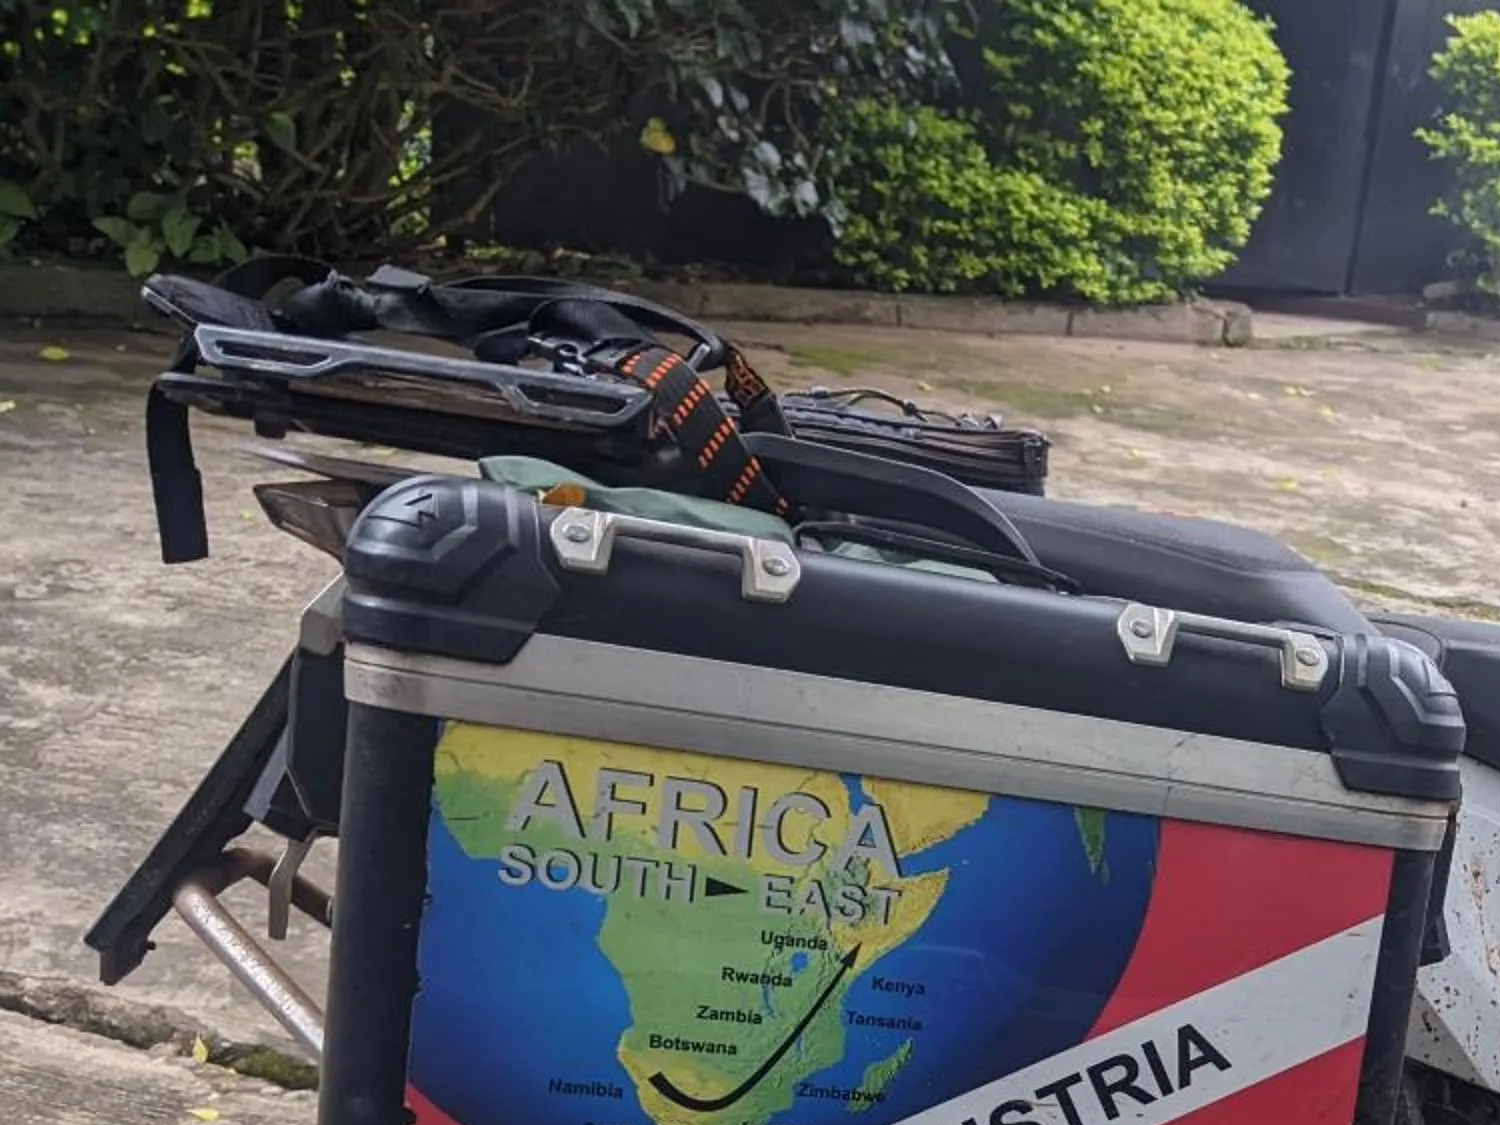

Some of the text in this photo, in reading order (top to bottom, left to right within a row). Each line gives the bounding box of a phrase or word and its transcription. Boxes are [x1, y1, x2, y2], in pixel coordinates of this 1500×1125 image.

[506, 759, 903, 878] AFRICA
[498, 844, 902, 926] SOUTH EAST
[761, 930, 829, 953] Uganda
[721, 967, 793, 989] Rwanda
[872, 976, 926, 998] Kenya
[696, 1005, 763, 1025] Zambia
[846, 1011, 923, 1032] Tansania
[649, 1034, 738, 1056] Botswana
[548, 1079, 623, 1099] Namibia
[798, 1083, 886, 1102] Zimbabwe
